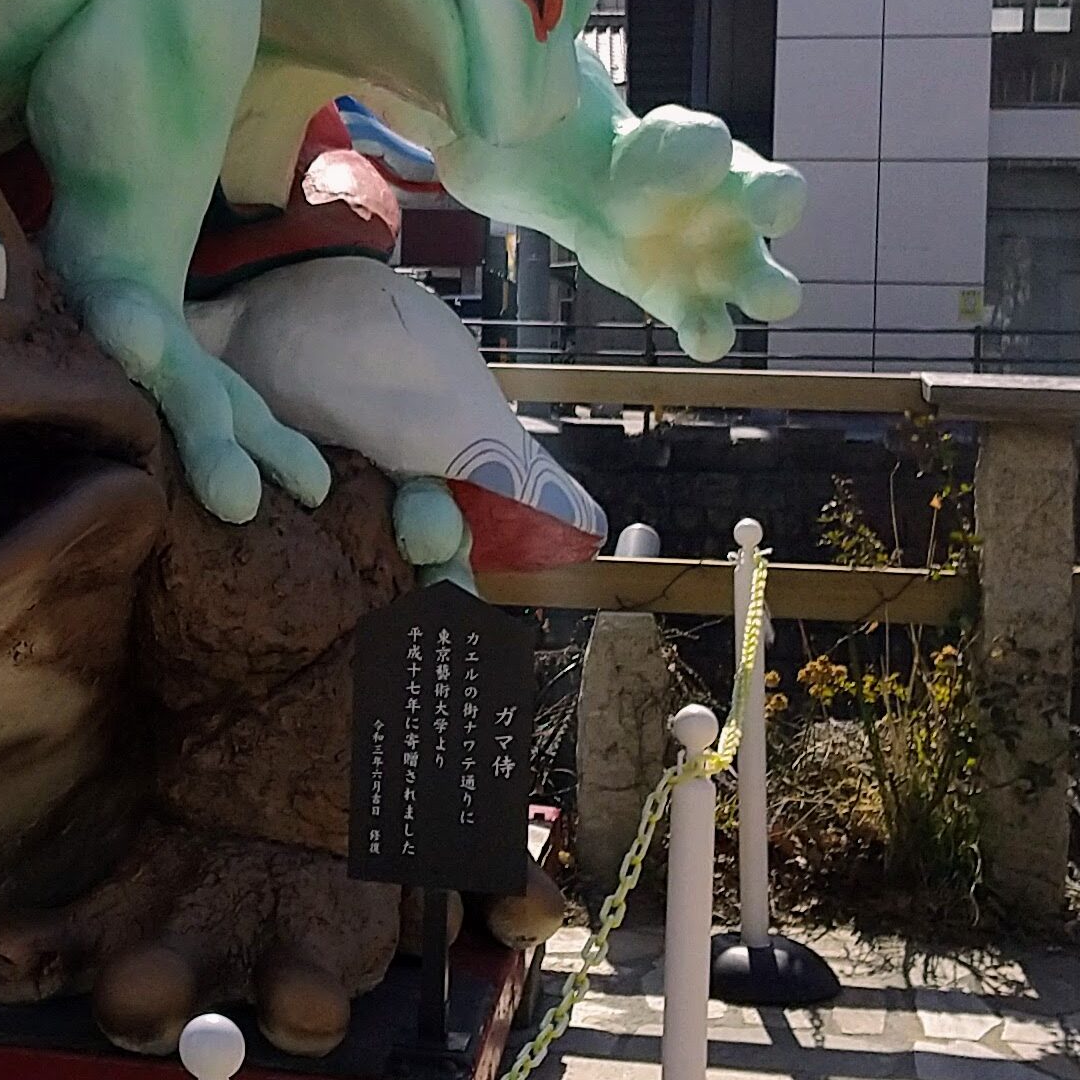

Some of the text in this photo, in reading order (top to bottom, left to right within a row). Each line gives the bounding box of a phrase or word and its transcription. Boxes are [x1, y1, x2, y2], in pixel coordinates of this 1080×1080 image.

[402, 627, 423, 855] 平成十七年に寄贈されました
[433, 628, 452, 768] 東京藝術大学より
[460, 632, 480, 824] カエルの街ナワテ通りに
[491, 706, 517, 780] ガマ侍
